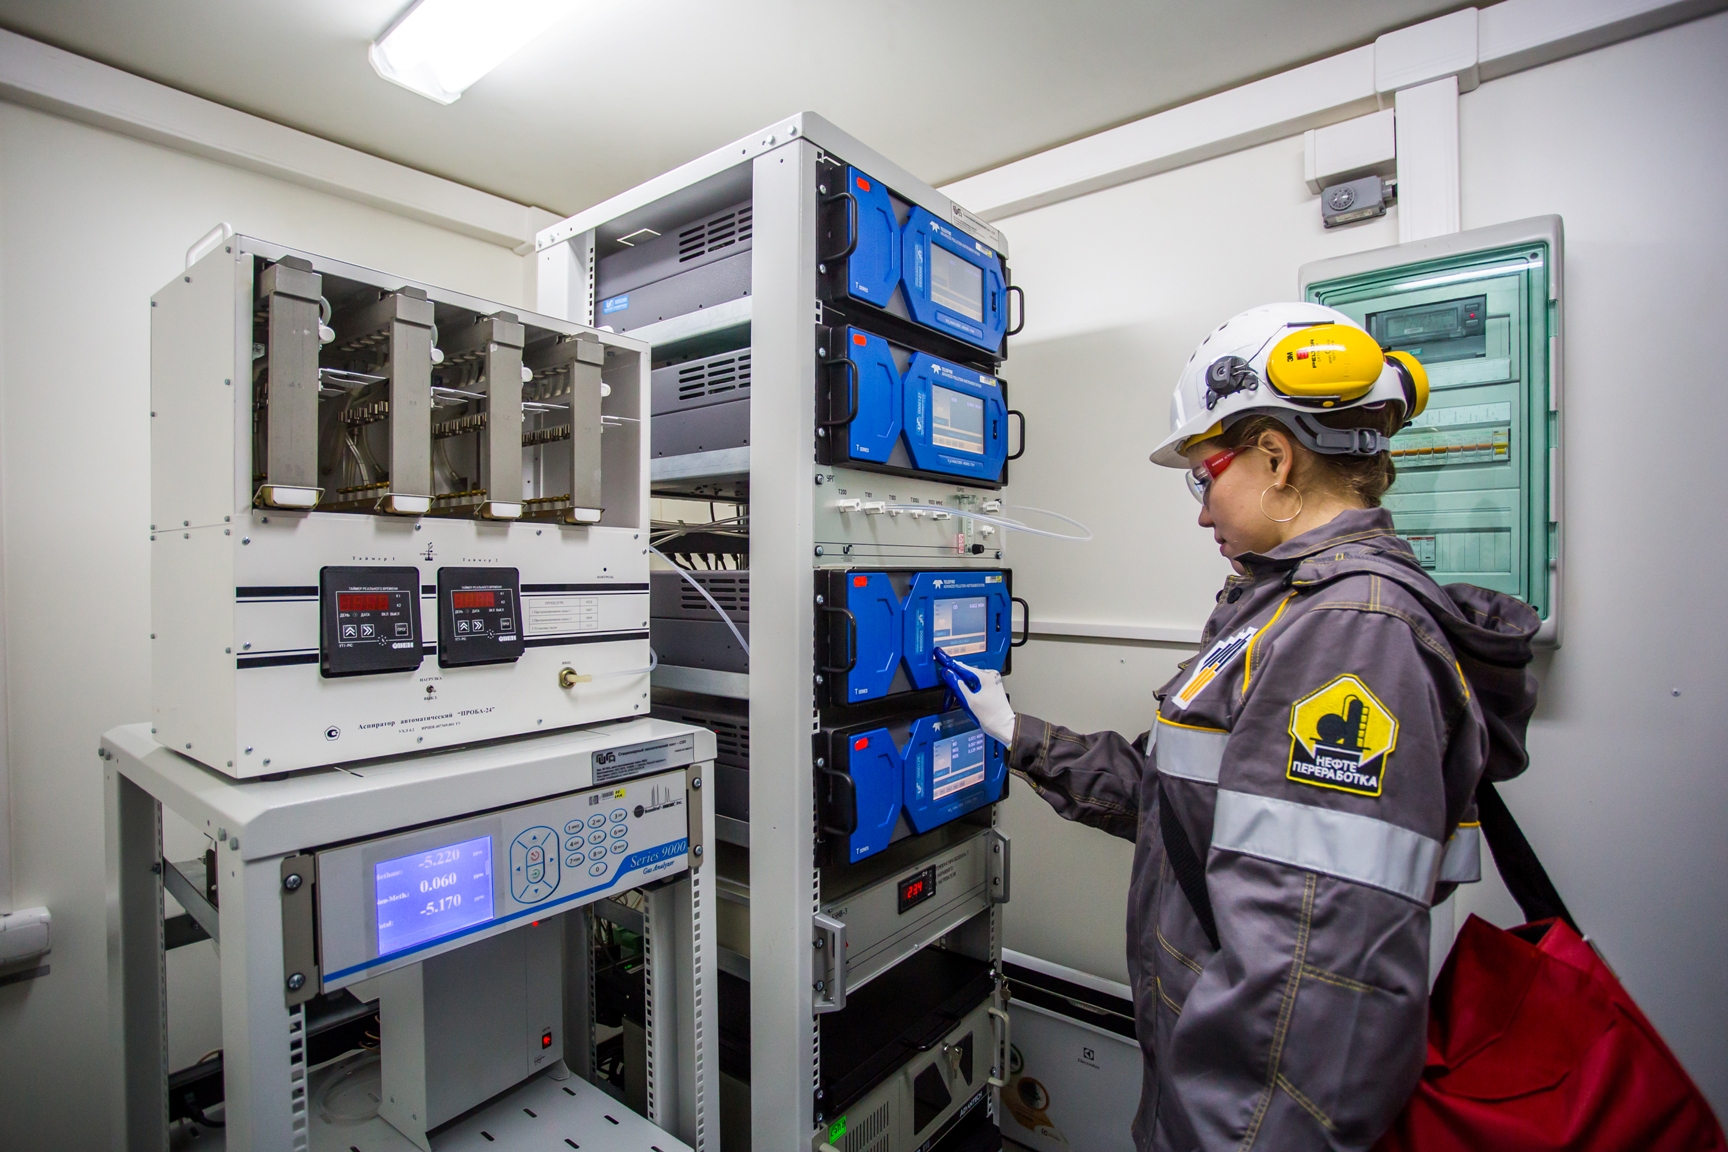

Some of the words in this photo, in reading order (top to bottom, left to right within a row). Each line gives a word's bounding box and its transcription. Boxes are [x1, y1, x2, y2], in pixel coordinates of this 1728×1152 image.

[1287, 351, 1294, 362] 3M
[358, 720, 396, 730] Аспиратор
[400, 712, 453, 725] автоматический
[1292, 761, 1378, 788] ПЕРЕРАБОТКА
[1316, 755, 1358, 773] НЕФТЕ
[418, 848, 460, 869] -5.220
[630, 851, 659, 868] Series
[661, 840, 687, 858] 9000
[642, 867, 653, 875] Gas
[652, 860, 675, 872] Analyzer
[420, 872, 457, 893] 0.060
[420, 894, 462, 916] -5.170
[959, 1090, 983, 1118] ADVANTECH
